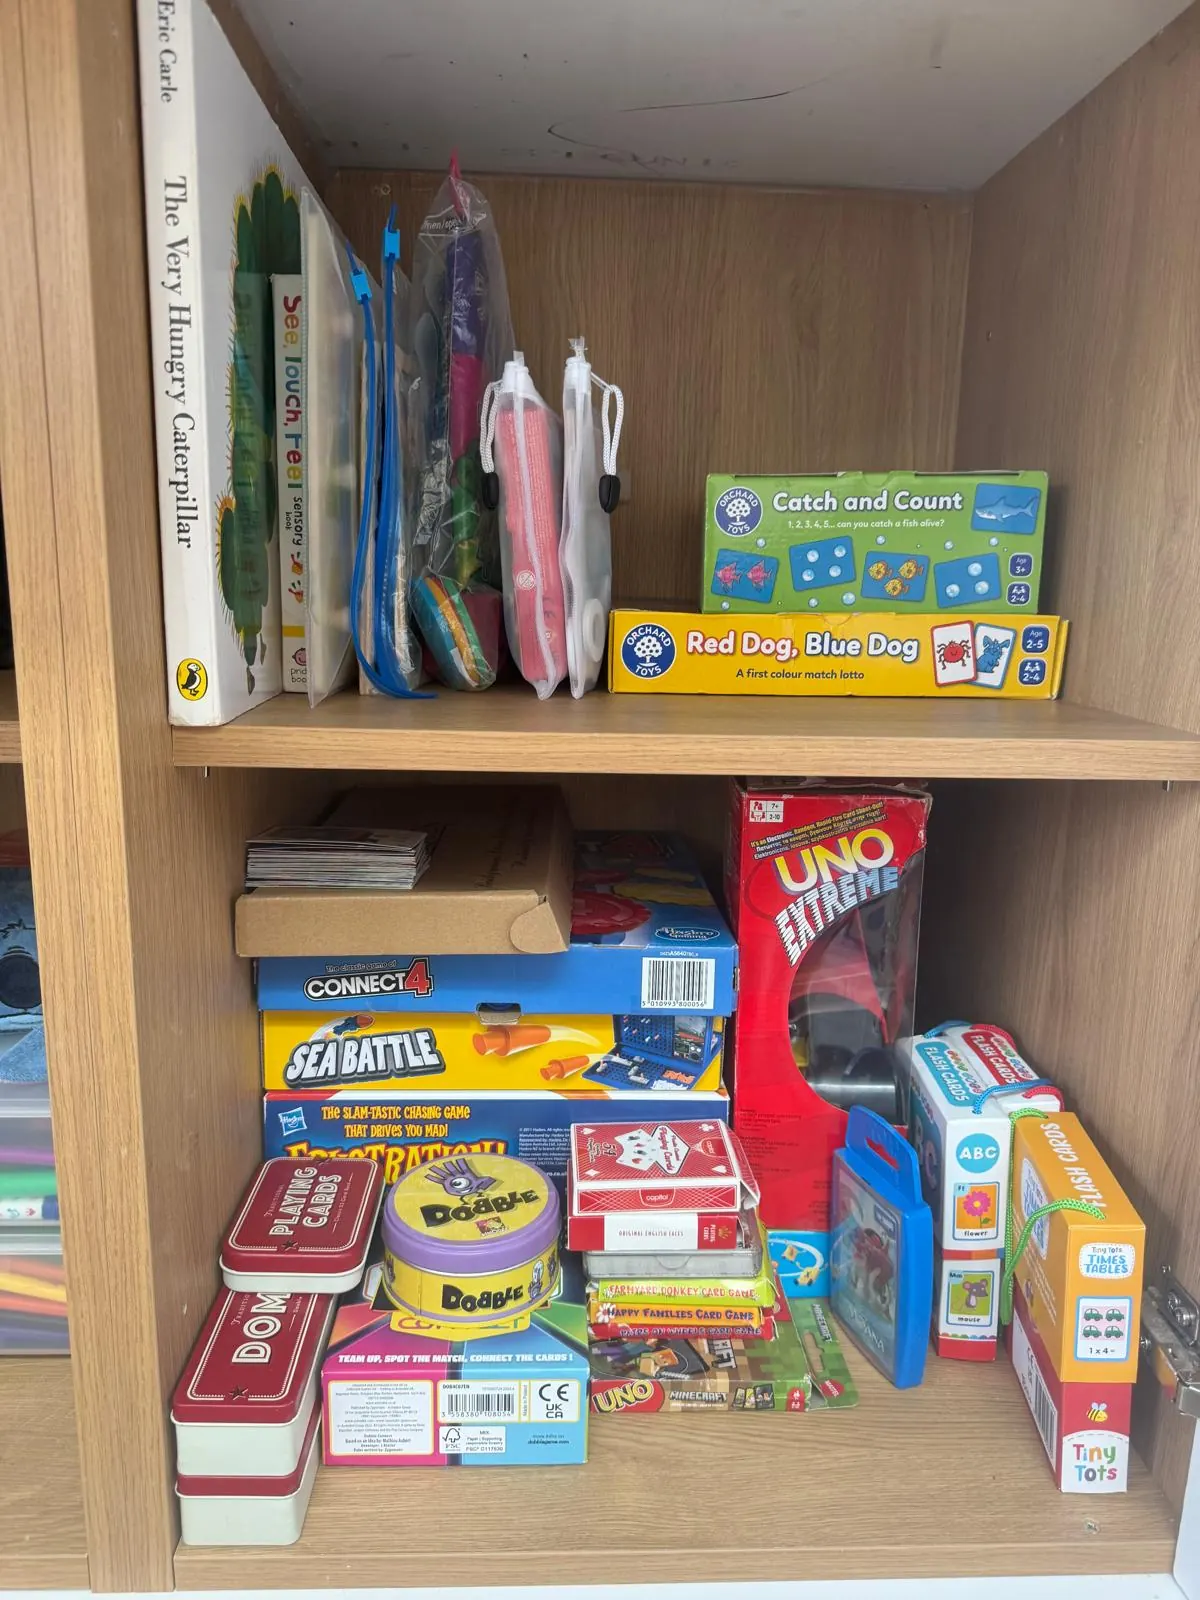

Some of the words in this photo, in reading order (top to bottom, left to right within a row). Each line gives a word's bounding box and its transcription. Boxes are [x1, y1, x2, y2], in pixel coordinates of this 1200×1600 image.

[157, 0, 176, 42] Eric
[158, 49, 178, 103] Carle
[164, 175, 188, 226] The
[161, 236, 189, 295] Very
[283, 295, 303, 348] See,
[165, 303, 192, 404] Hungry
[284, 433, 304, 489] Feel
[168, 412, 198, 548] Caterpillar
[719, 489, 758, 507] ORCHARD
[773, 490, 838, 513] Catch
[844, 489, 889, 512] and
[893, 490, 963, 512] Count
[292, 497, 304, 547] sensory
[726, 523, 751, 534] TOYS
[853, 521, 868, 530] you
[870, 519, 893, 528] catch
[902, 519, 918, 528] fish
[920, 519, 945, 528] alive?
[1015, 566, 1026, 574] 3+
[1011, 594, 1025, 603] 2-4
[626, 626, 672, 647] ORCHARD
[1029, 630, 1043, 638] Age
[686, 630, 735, 656] Red
[741, 631, 800, 662] Dog,
[805, 631, 861, 657] Blue
[867, 632, 920, 664] Dog
[1026, 640, 1044, 650] 2-5
[635, 665, 662, 677] TOYS
[736, 669, 744, 678] A
[746, 668, 768, 678] first
[770, 669, 802, 679] colour
[804, 669, 837, 679] match
[839, 669, 865, 680] lotto
[1023, 672, 1040, 682] 2-4
[774, 828, 894, 893] UNO
[774, 867, 898, 967] EXTREME
[307, 972, 406, 997] CONNECT
[404, 961, 430, 994] 4
[286, 1041, 337, 1080] SEA
[341, 1031, 440, 1075] BATTLE
[970, 1035, 997, 1057] FLASH
[989, 1056, 1019, 1084] CARDS
[924, 1046, 951, 1073] FLASH
[940, 1071, 970, 1102] CARDS
[321, 1106, 340, 1120] THE
[342, 1106, 401, 1119] SLAM-TASTIC
[404, 1106, 442, 1119] CHASING
[444, 1106, 471, 1119] GAME
[344, 1124, 367, 1138] THAT
[370, 1124, 403, 1138] DRIVES
[405, 1124, 424, 1137] YOU
[425, 1123, 449, 1137] MAD!
[1040, 1122, 1080, 1162] CARDS
[284, 1140, 506, 1184] FTRATION!
[959, 1146, 997, 1160] ABC
[1064, 1165, 1107, 1208] FLASH
[268, 1166, 318, 1236] PLAYING
[302, 1174, 342, 1228] CARDS
[1088, 1254, 1127, 1265] TIMES
[1092, 1246, 1107, 1254] Tiny
[1084, 1264, 1129, 1274] TABLES
[609, 1285, 657, 1297] FARMYARD
[661, 1286, 698, 1297] DONKEY
[701, 1287, 726, 1297] CARD
[728, 1288, 755, 1297] GAME
[607, 1307, 639, 1317] HAPPY
[642, 1307, 693, 1319] FAMILIES
[695, 1309, 722, 1320] CARD
[725, 1310, 754, 1321] GAME
[231, 1292, 292, 1363] DOM
[338, 1354, 365, 1363] TEAM
[366, 1354, 383, 1364] UP,
[384, 1355, 409, 1363] SPOT
[411, 1355, 431, 1363] THE
[432, 1355, 468, 1363] MATCH,
[470, 1354, 513, 1362] CONNECT
[514, 1354, 534, 1362] THE
[535, 1354, 567, 1362] CARDS
[539, 1383, 569, 1402] CE
[591, 1380, 654, 1413] UNO
[669, 1391, 728, 1403] MINECRAFT
[546, 1403, 562, 1411] UK
[546, 1411, 563, 1419] CA
[1072, 1443, 1117, 1465] Tiny
[1074, 1465, 1118, 1482] Tots
